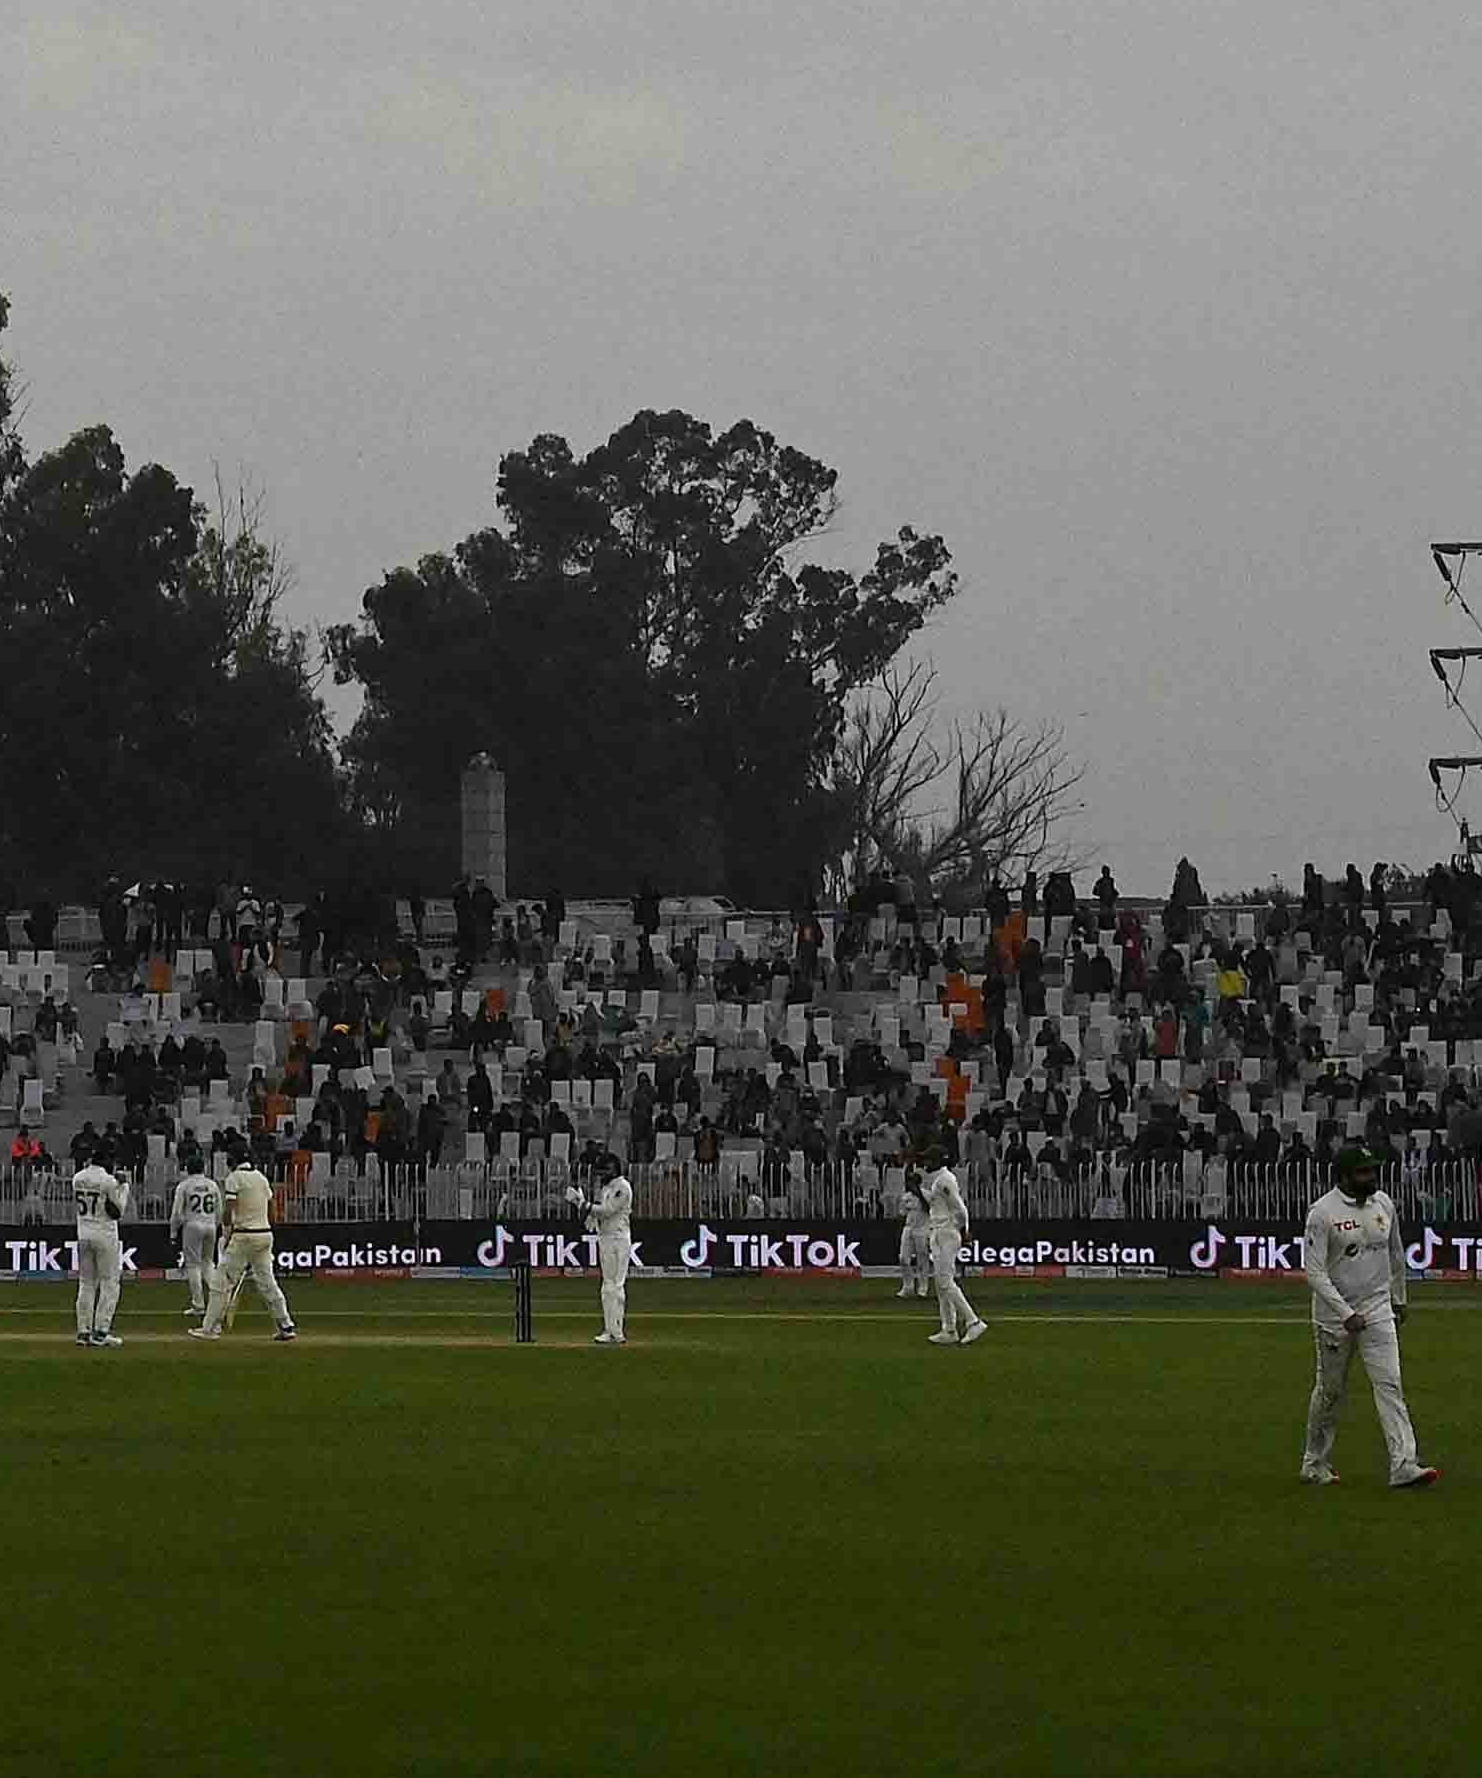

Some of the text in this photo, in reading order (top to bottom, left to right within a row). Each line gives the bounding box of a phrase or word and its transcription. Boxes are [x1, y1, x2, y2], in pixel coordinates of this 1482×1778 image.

[189, 1194, 213, 1214] 26
[1334, 1220, 1360, 1232] TCL
[4, 1240, 139, 1271] TikTk
[726, 1234, 861, 1268] TikTok
[1235, 1235, 1306, 1270] TikT
